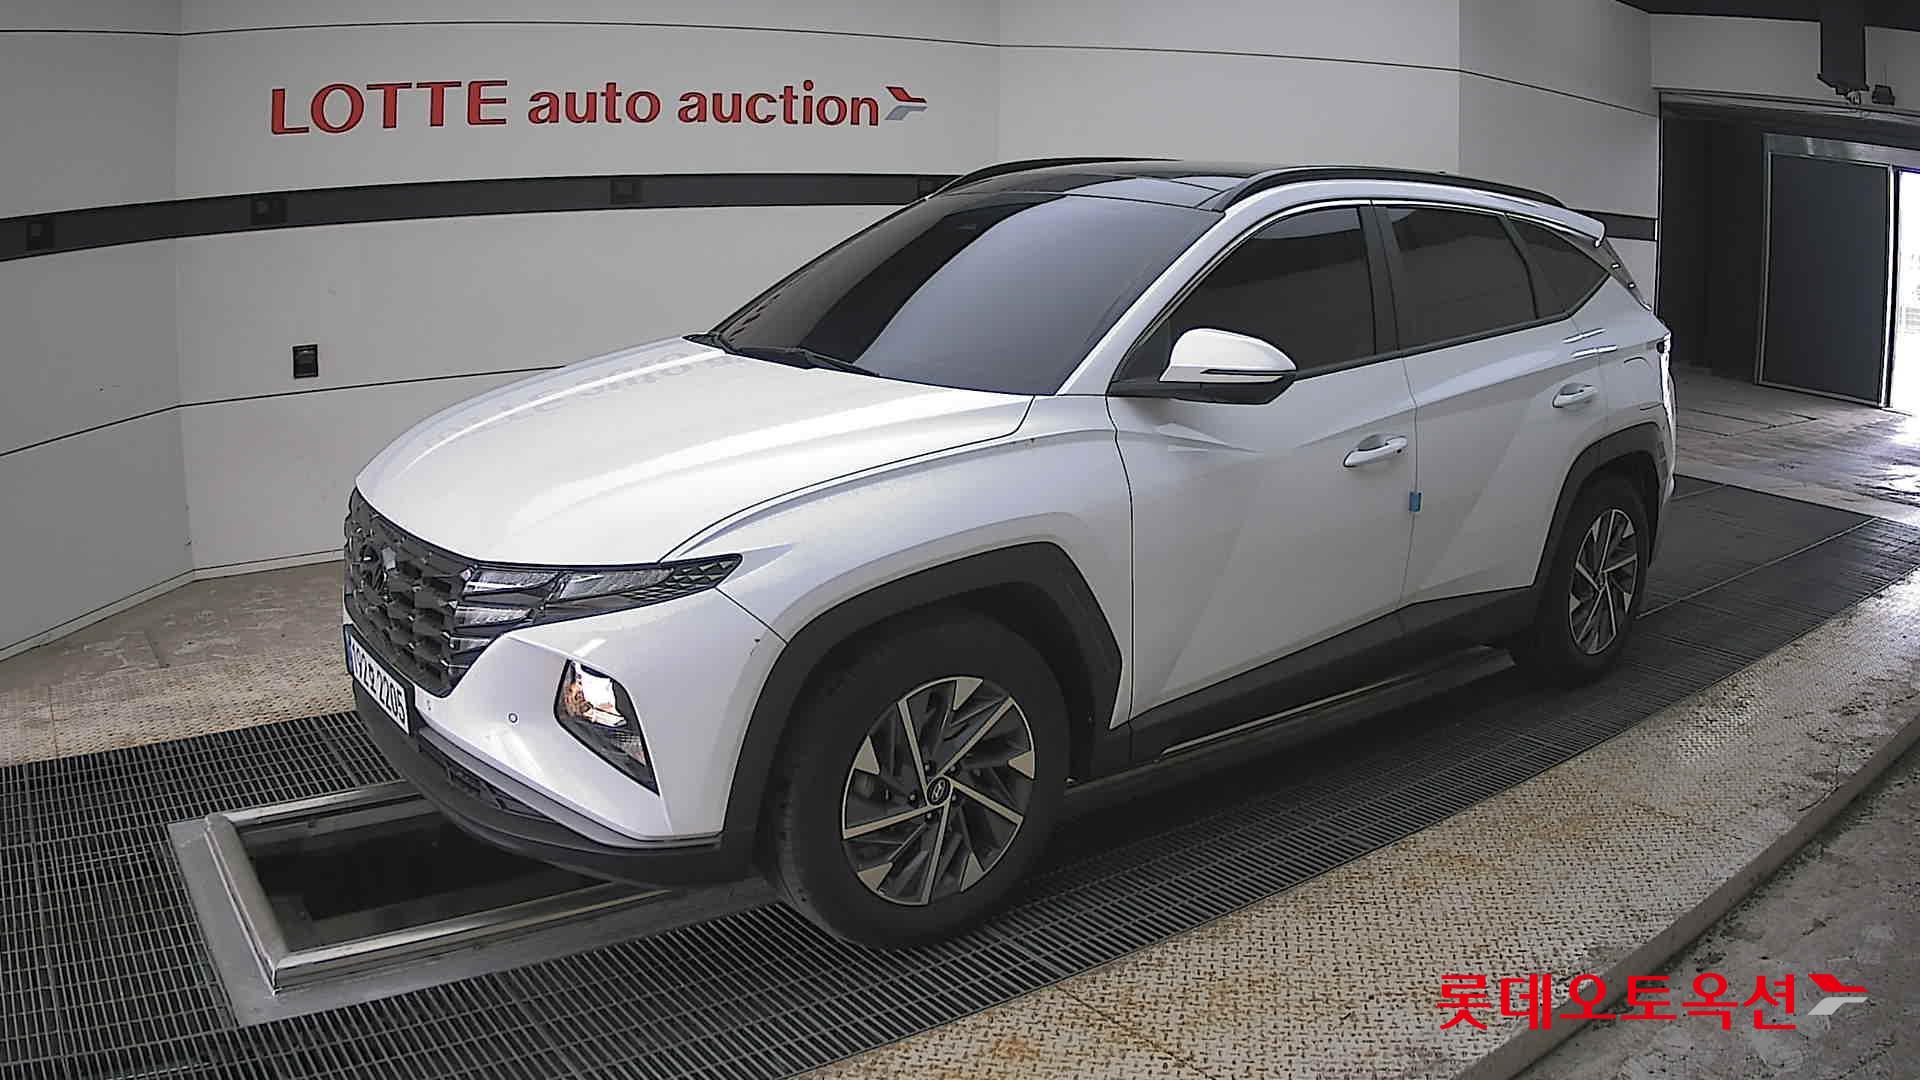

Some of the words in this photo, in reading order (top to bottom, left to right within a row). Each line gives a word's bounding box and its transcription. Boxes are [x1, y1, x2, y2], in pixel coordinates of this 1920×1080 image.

[271, 80, 507, 135] LOTTE
[528, 82, 663, 125] auto
[678, 80, 881, 126] auction
[376, 669, 407, 724] 2205
